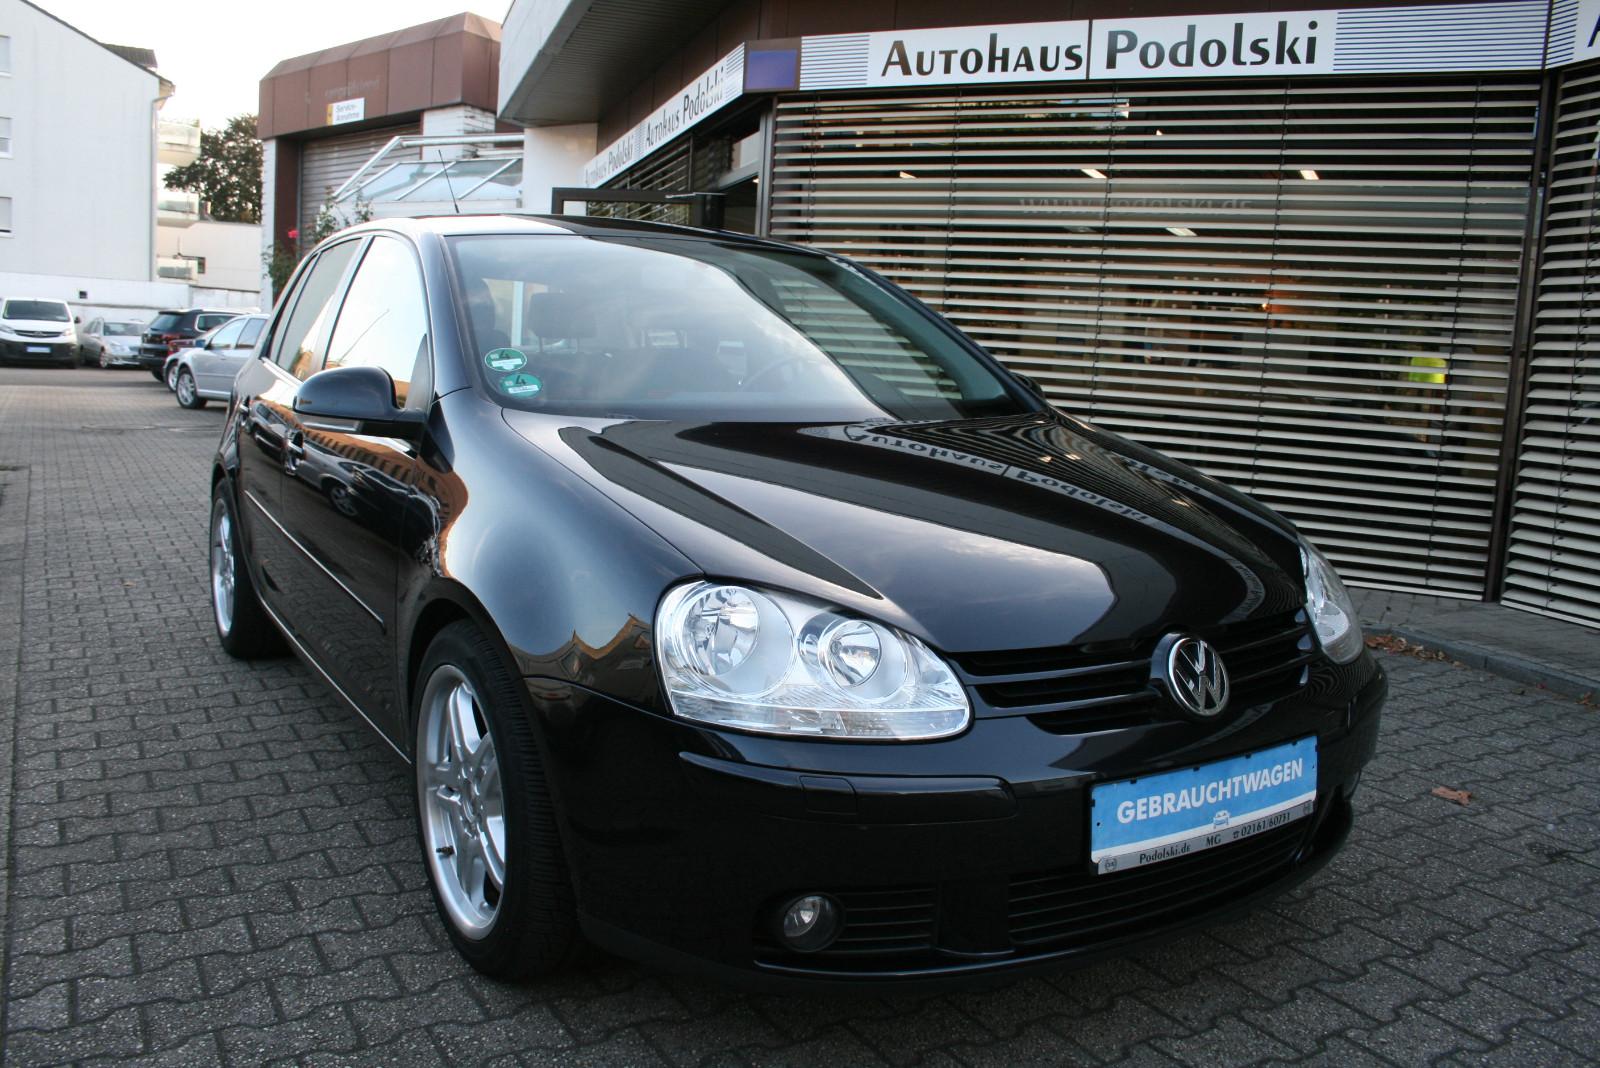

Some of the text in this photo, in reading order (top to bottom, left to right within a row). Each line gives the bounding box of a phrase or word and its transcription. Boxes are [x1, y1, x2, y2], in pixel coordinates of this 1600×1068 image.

[881, 20, 1318, 77] AUTOHAUS Podolski
[682, 66, 724, 125] Podolski
[515, 374, 527, 385] 4
[1116, 757, 1303, 824] GEBRAUCHTWAGEN
[1205, 834, 1222, 847] MG
